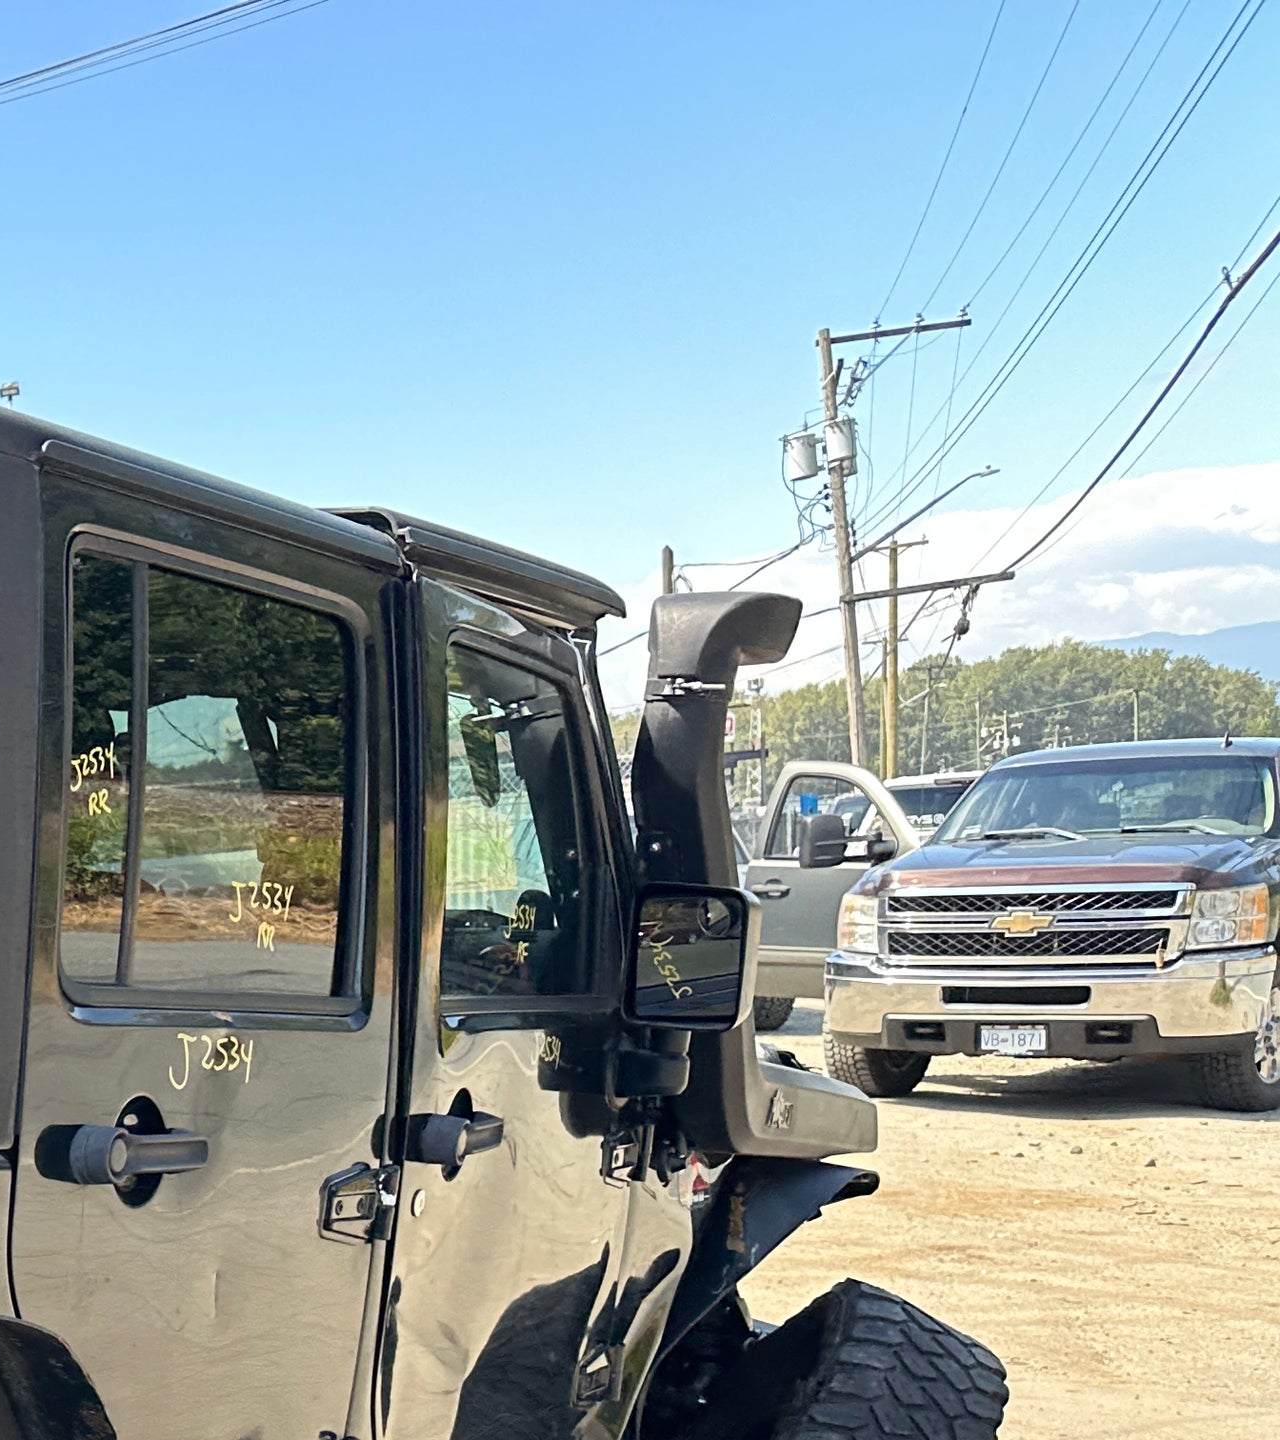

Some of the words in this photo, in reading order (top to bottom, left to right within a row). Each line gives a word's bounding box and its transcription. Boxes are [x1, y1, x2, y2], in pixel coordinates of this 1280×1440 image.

[70, 741, 115, 792] J2534
[88, 788, 112, 816] RR
[229, 881, 295, 923] J2534
[167, 1032, 254, 1091] J2534
